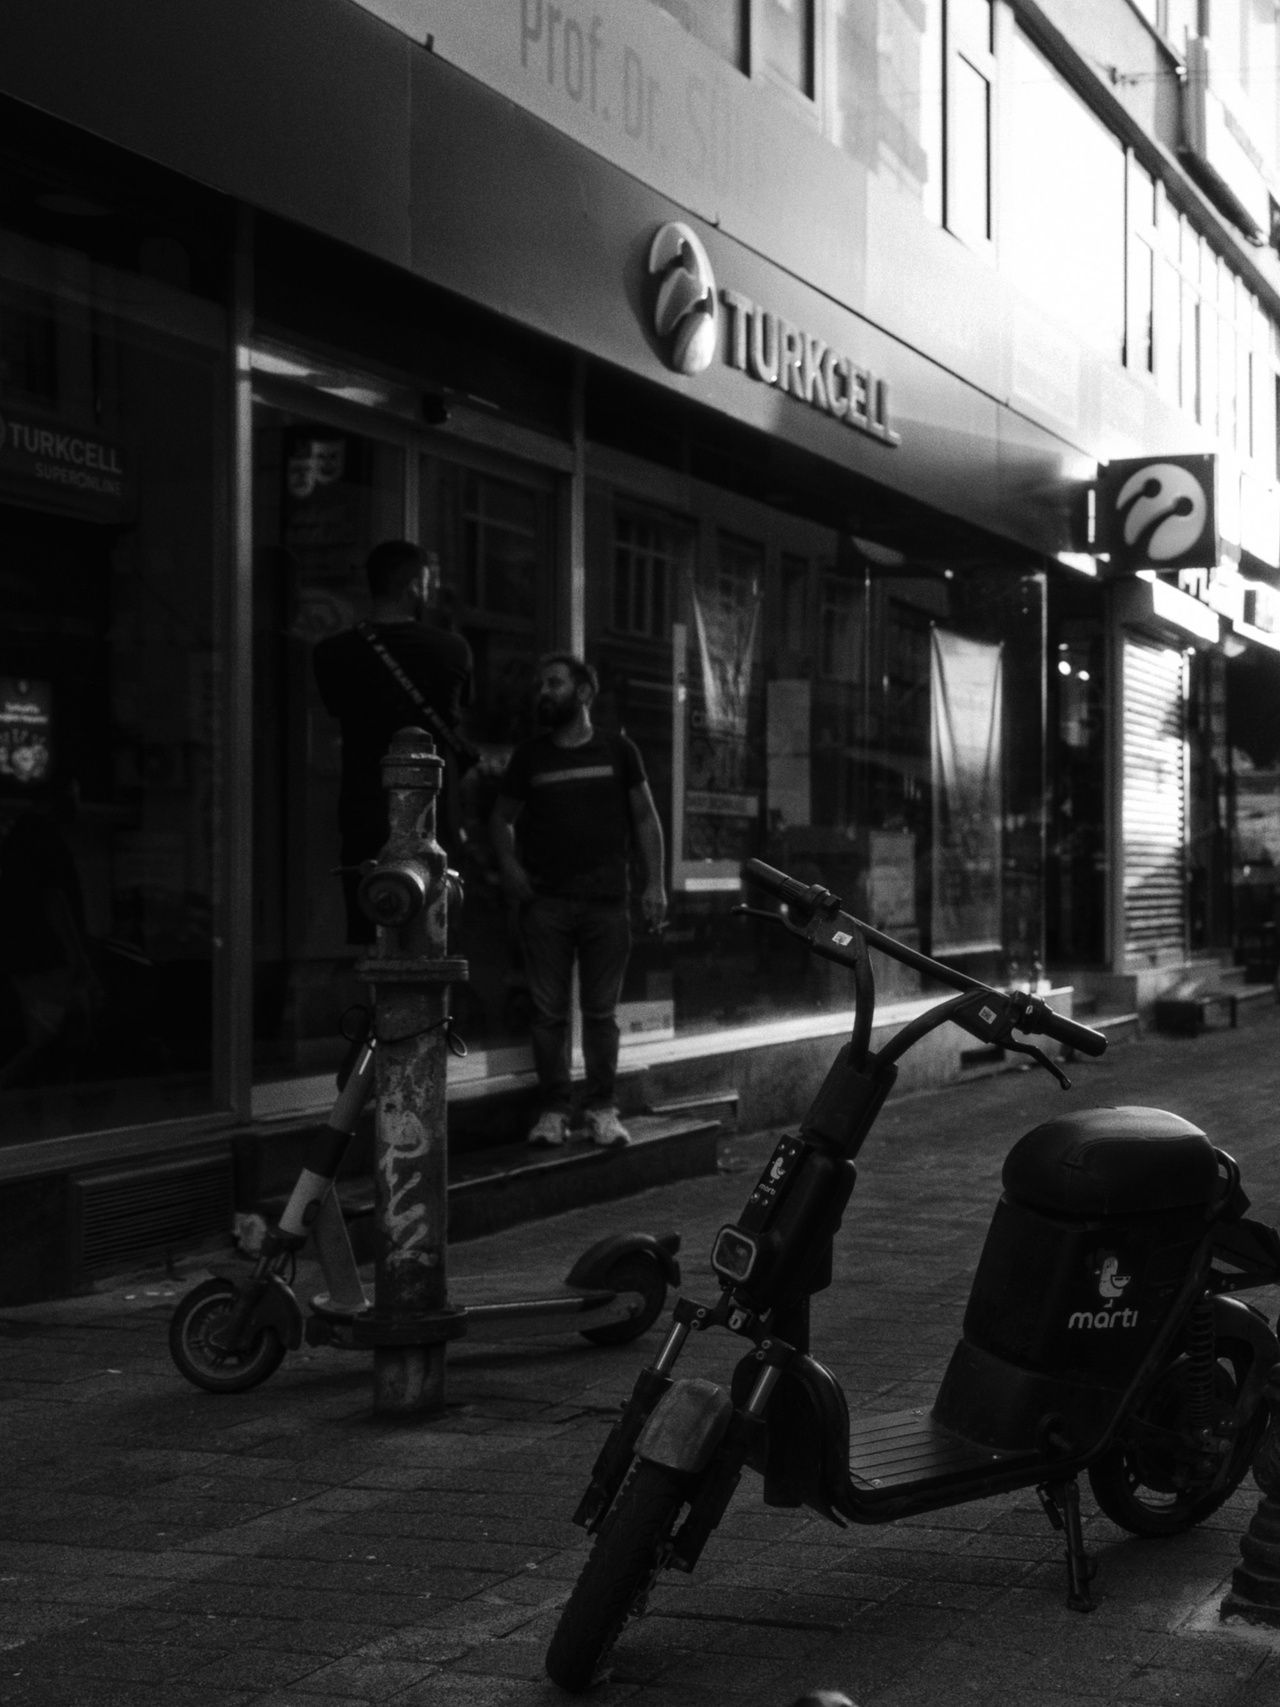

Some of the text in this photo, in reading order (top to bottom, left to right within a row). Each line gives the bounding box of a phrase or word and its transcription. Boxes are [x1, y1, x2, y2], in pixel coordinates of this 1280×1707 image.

[718, 288, 901, 446] TURKCELL
[8, 421, 123, 475] TURKCELL
[34, 461, 122, 497] SUPERONLINE
